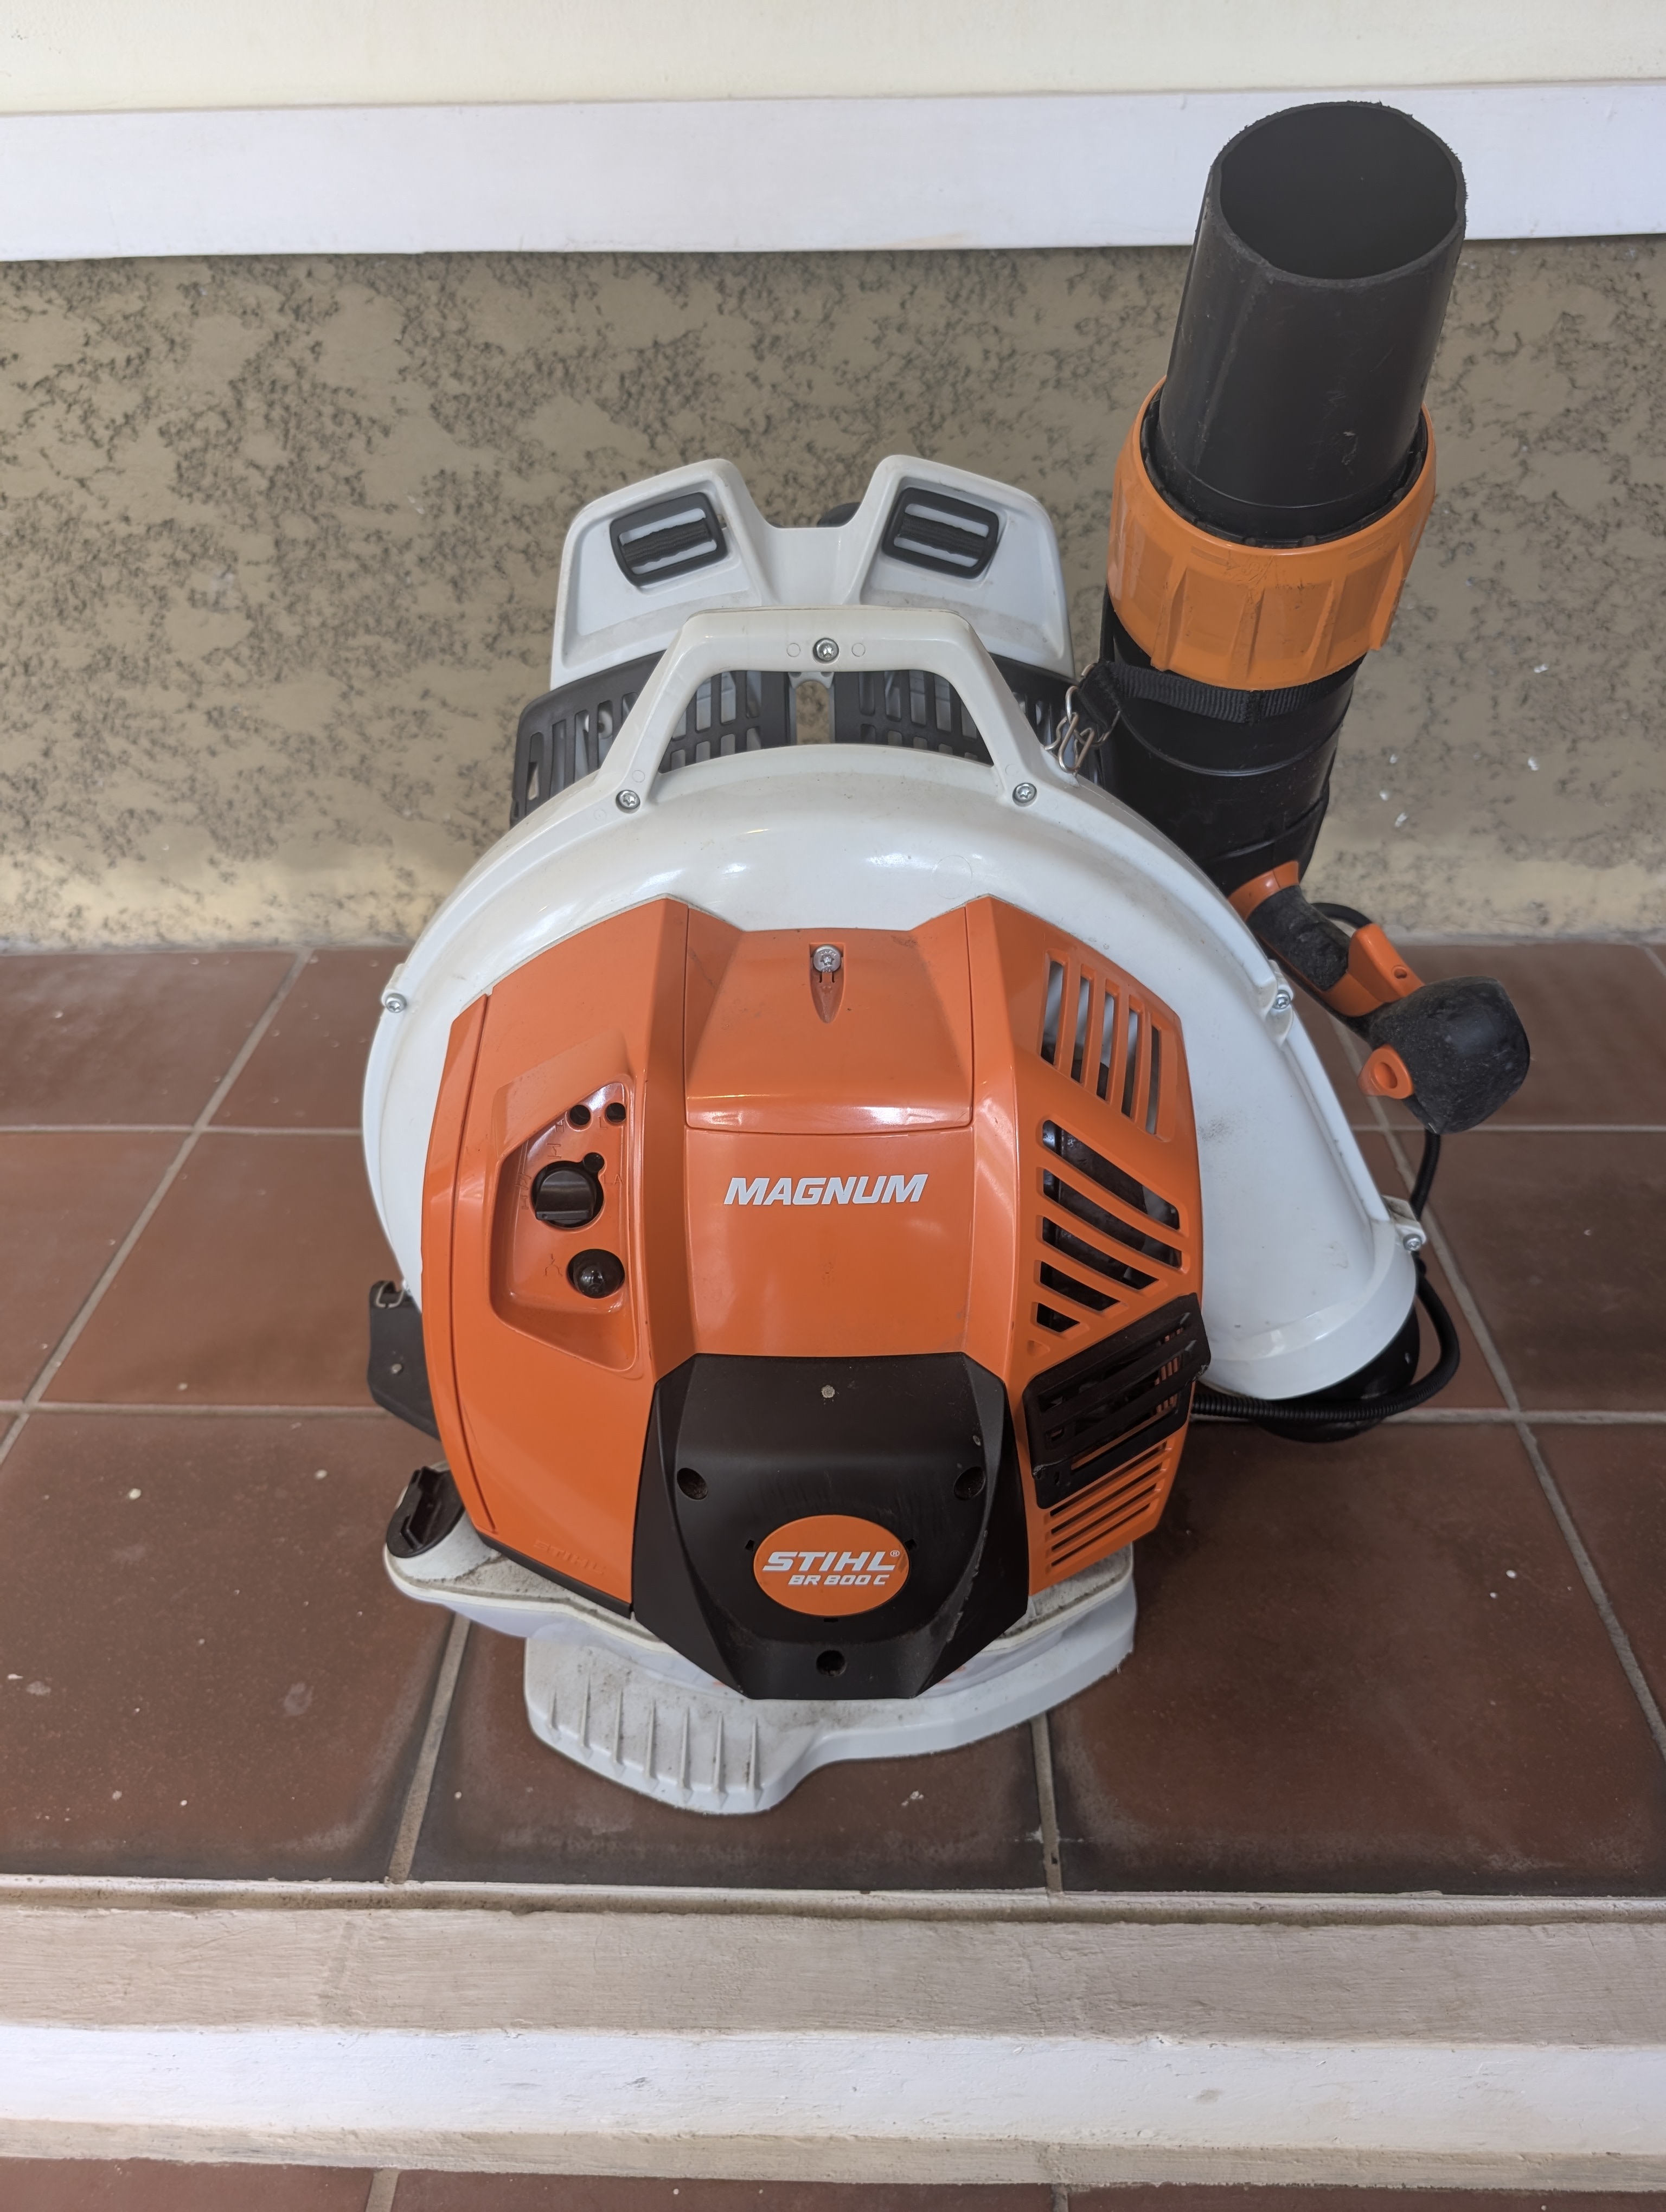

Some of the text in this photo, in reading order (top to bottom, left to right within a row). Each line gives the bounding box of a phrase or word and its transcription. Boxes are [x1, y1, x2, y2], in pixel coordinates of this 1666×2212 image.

[598, 1116, 608, 1129] L
[723, 1174, 928, 1206] MAGNUM
[533, 1540, 606, 1574] STIHL
[788, 1574, 890, 1586] BR 800 C
